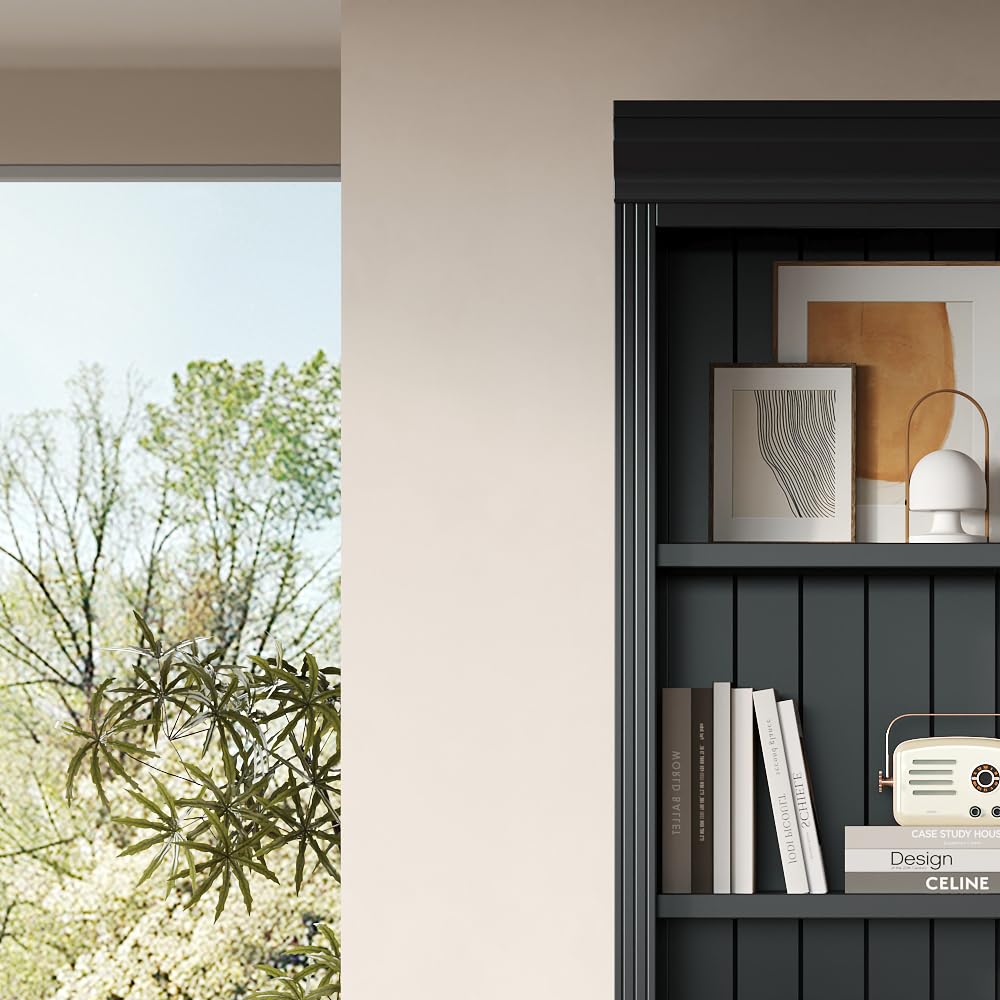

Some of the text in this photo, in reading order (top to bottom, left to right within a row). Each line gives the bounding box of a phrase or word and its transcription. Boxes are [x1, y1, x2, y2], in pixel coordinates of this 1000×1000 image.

[911, 829, 938, 839] CASE
[940, 829, 971, 839] STUDY
[891, 851, 953, 870] Design
[925, 876, 990, 891] CELINE
